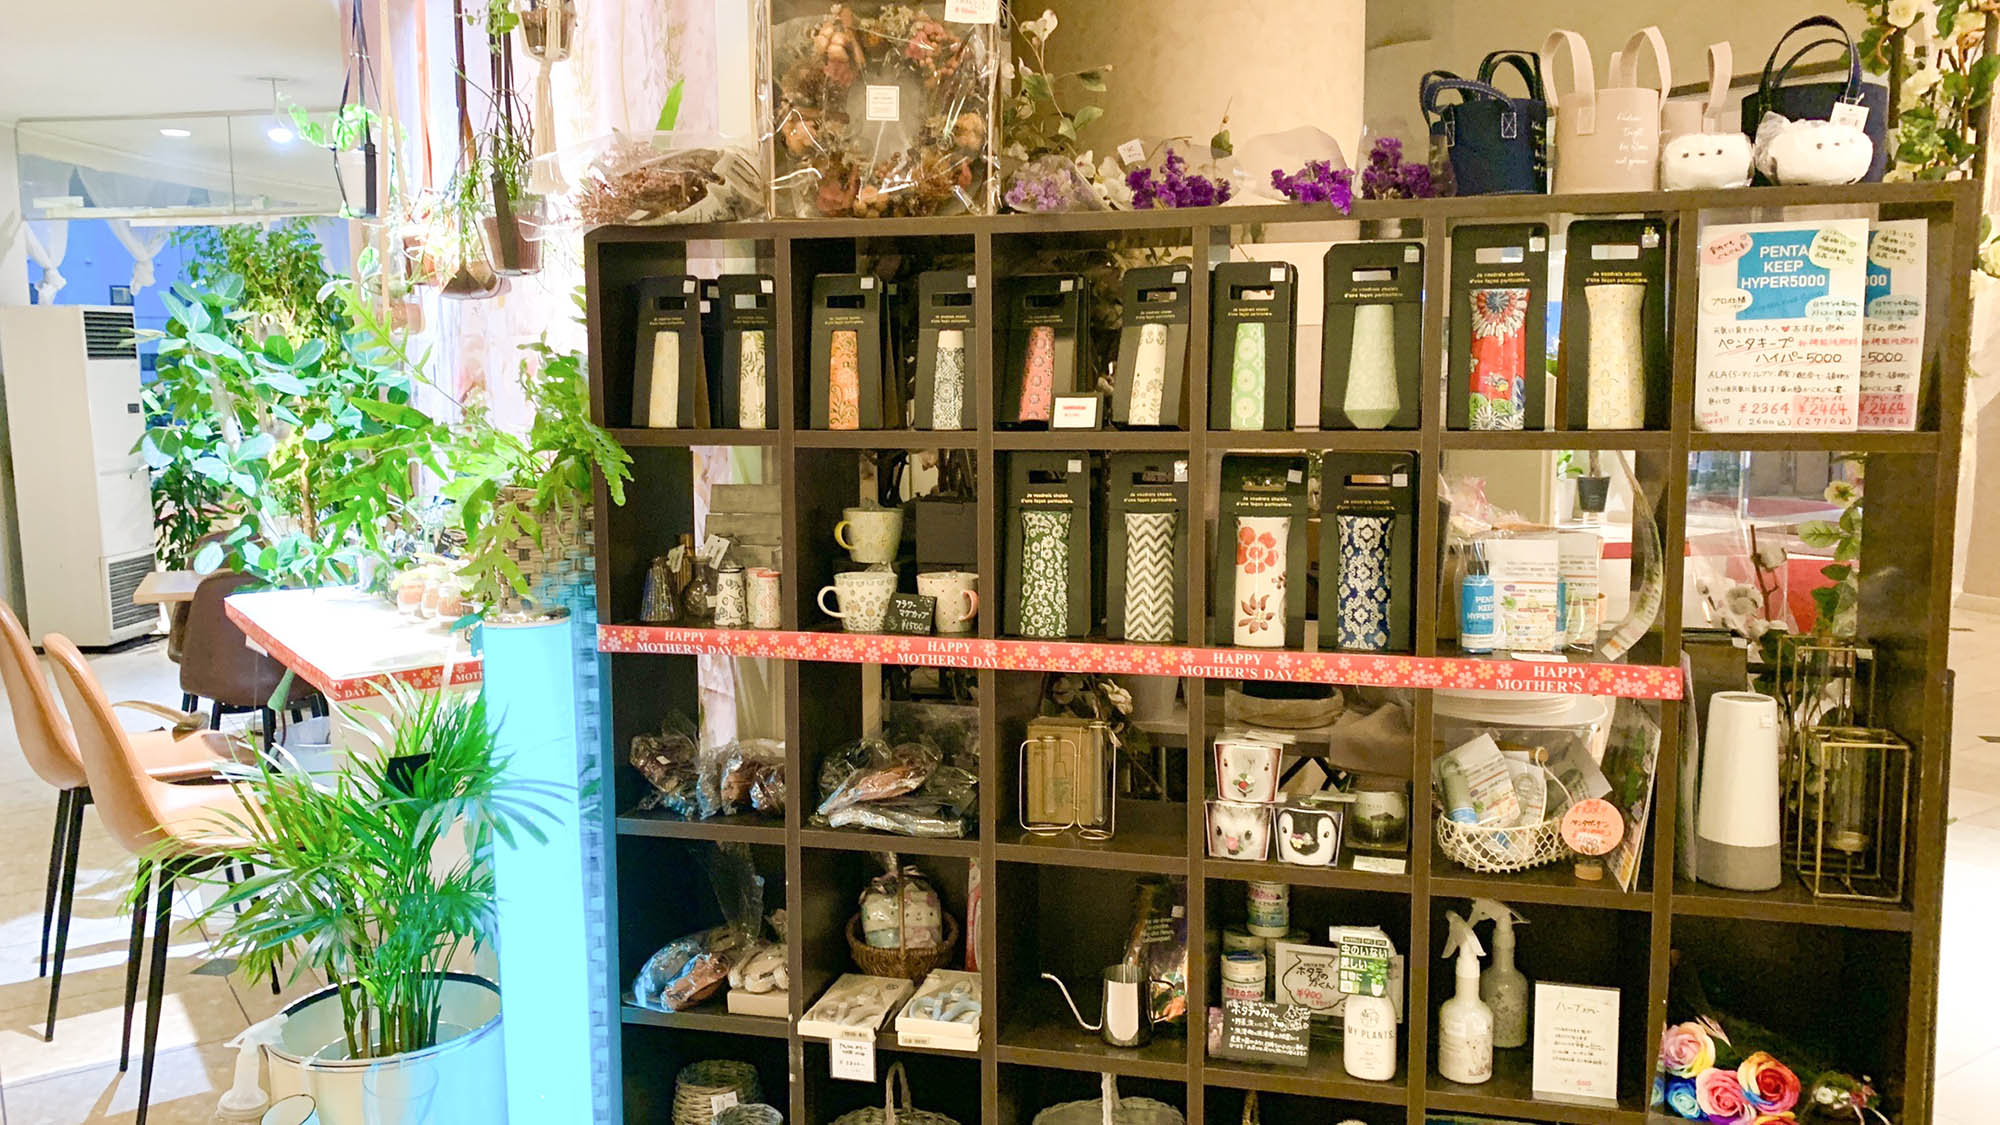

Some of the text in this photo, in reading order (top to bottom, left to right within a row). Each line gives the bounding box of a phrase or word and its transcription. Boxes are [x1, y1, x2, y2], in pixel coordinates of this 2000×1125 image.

[1760, 244, 1809, 258] PENTA
[1763, 260, 1804, 273] KEEP
[1741, 274, 1826, 289] HYPER5000
[1718, 337, 1795, 350] ペンタキープ
[1756, 350, 1843, 364] ハイパー5000
[1739, 402, 1790, 415] ¥2364
[895, 599, 918, 609] フラワー
[665, 631, 708, 642] HAPPY
[637, 641, 733, 656] MOTHER'S DAY
[927, 640, 973, 653] HAPPY
[897, 653, 1000, 668] MOTHER'S DAY
[1213, 652, 1263, 666] HAPPY
[1179, 664, 1295, 681] MOTHER'S DAY
[1533, 665, 1588, 679] HAPPY
[1495, 678, 1583, 693] MOTHER'S
[344, 687, 368, 699] DAY
